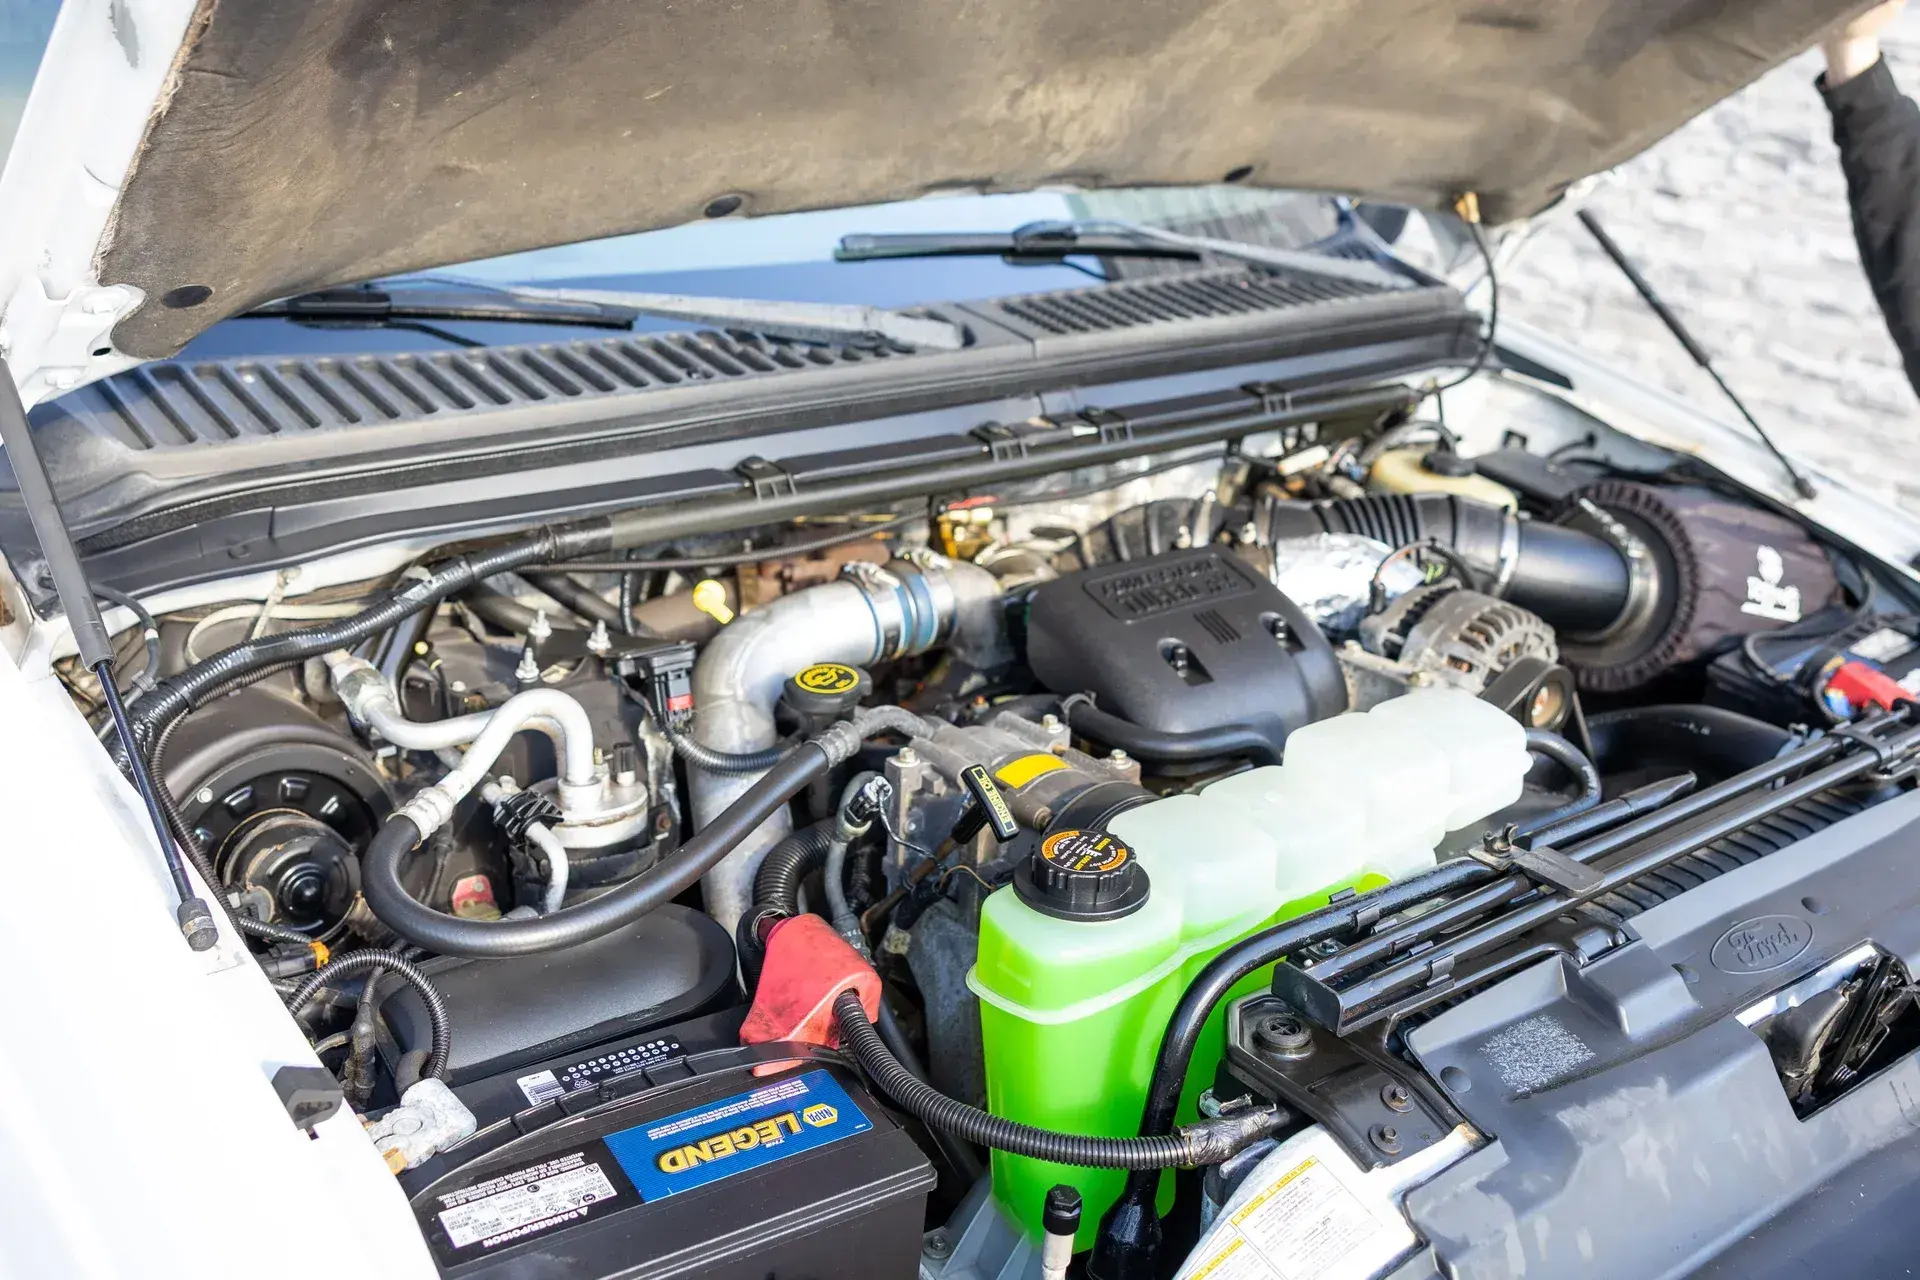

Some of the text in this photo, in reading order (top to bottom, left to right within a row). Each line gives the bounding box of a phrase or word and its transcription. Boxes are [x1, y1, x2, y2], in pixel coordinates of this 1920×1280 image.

[979, 774, 1011, 823] ENGINE OIL
[1727, 921, 1800, 967] Ford
[805, 1107, 834, 1122] NAPA
[657, 1110, 803, 1173] LEGEND
[763, 1138, 785, 1147] THE
[482, 1210, 579, 1248] DANGER/POISON
